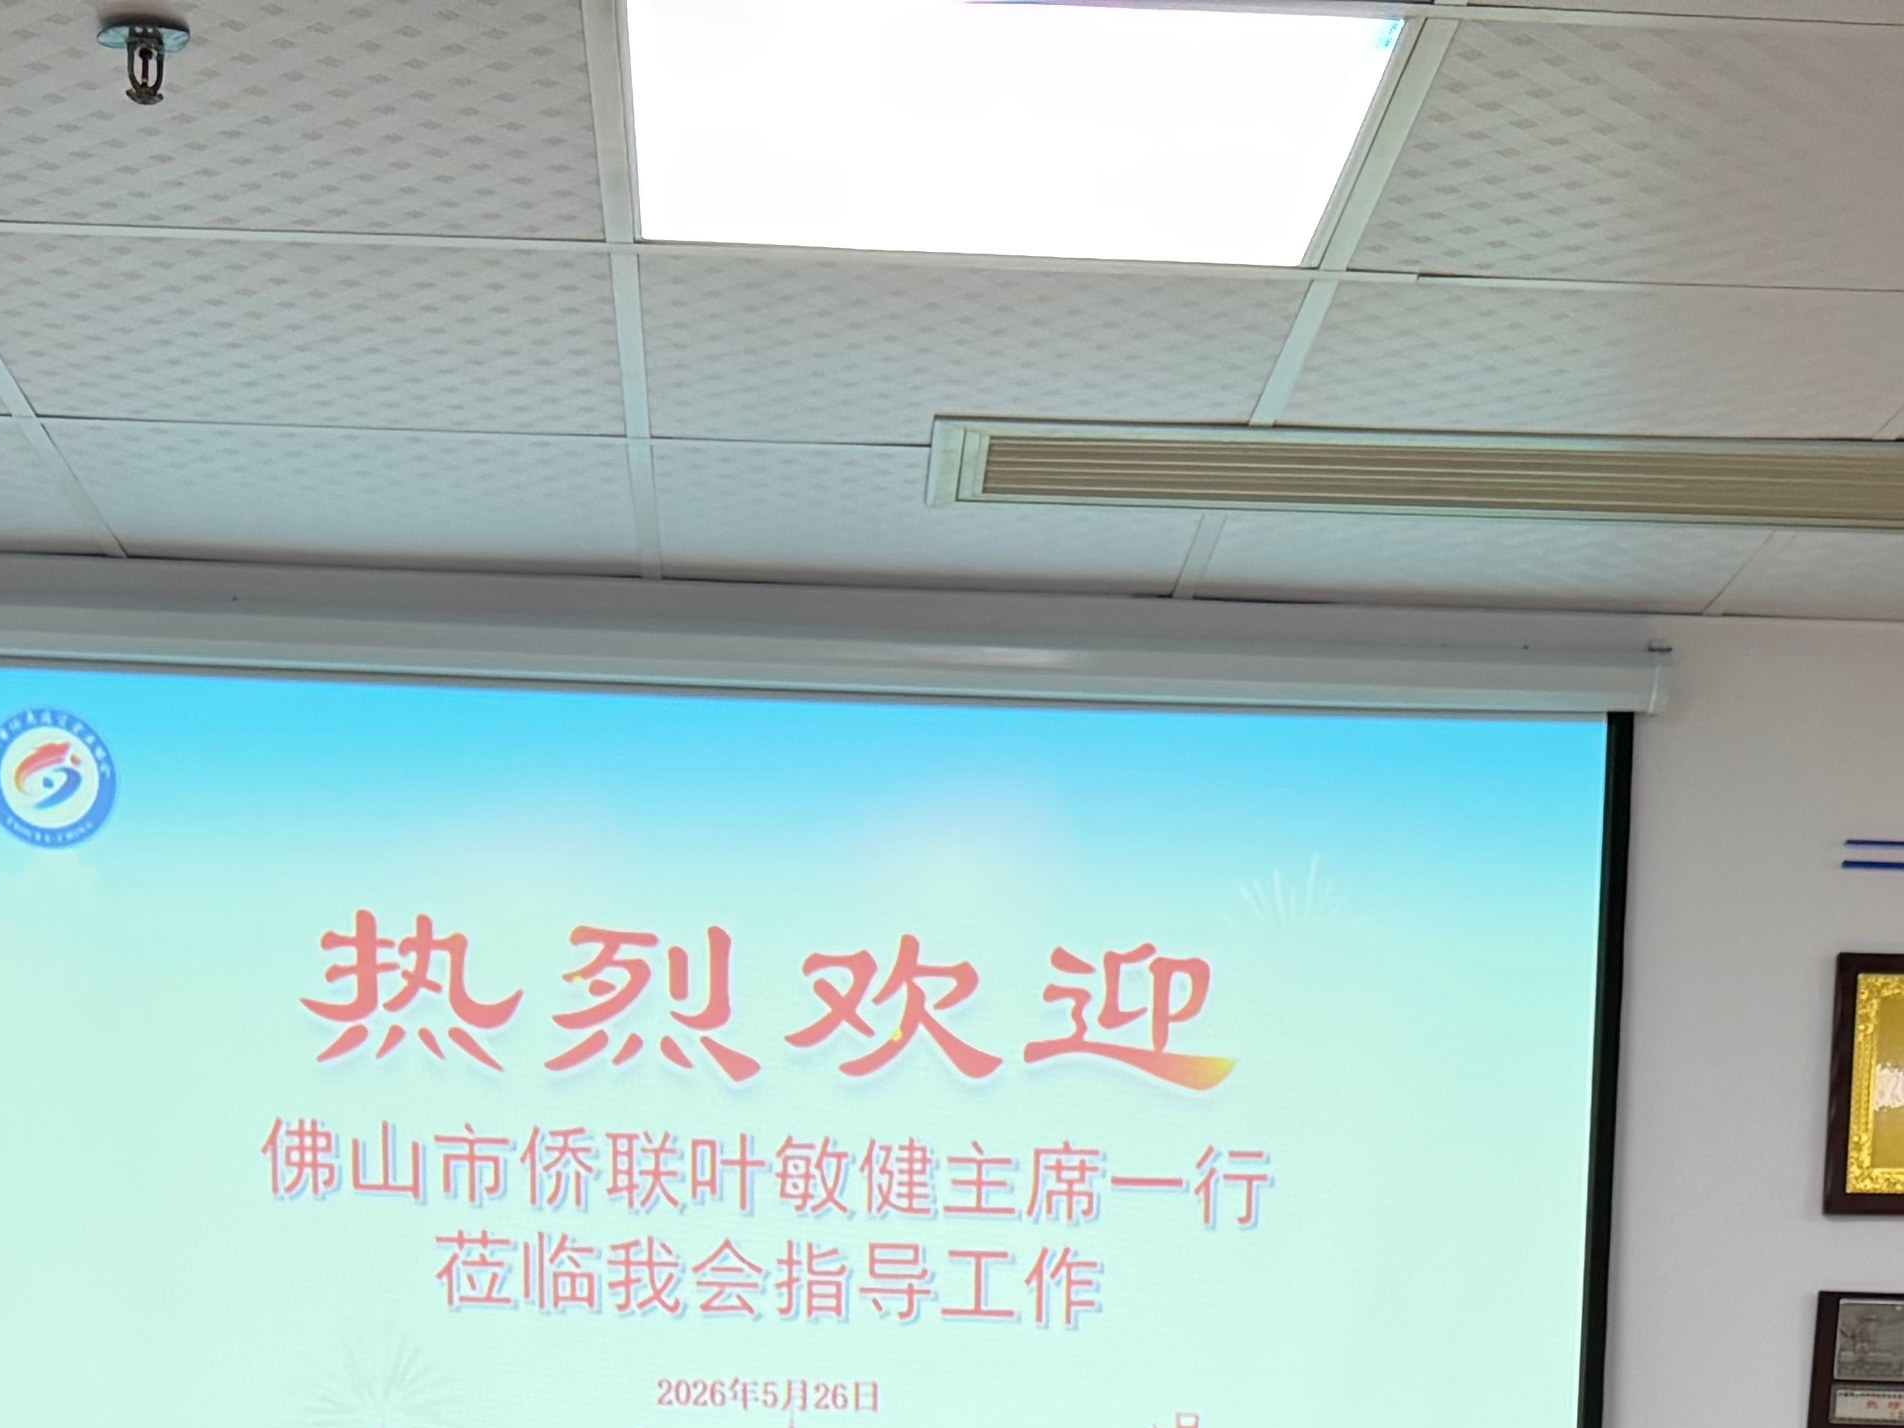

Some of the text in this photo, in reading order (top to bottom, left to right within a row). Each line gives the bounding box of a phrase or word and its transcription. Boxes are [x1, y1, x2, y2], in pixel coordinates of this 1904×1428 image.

[298, 908, 1240, 1091] 热烈欢迎
[261, 1118, 1275, 1231] 佛山市侨联叶敏健主席一行
[433, 1230, 1105, 1330] 莅临我会指导工作
[654, 1376, 882, 1416] 2026年5月26日
